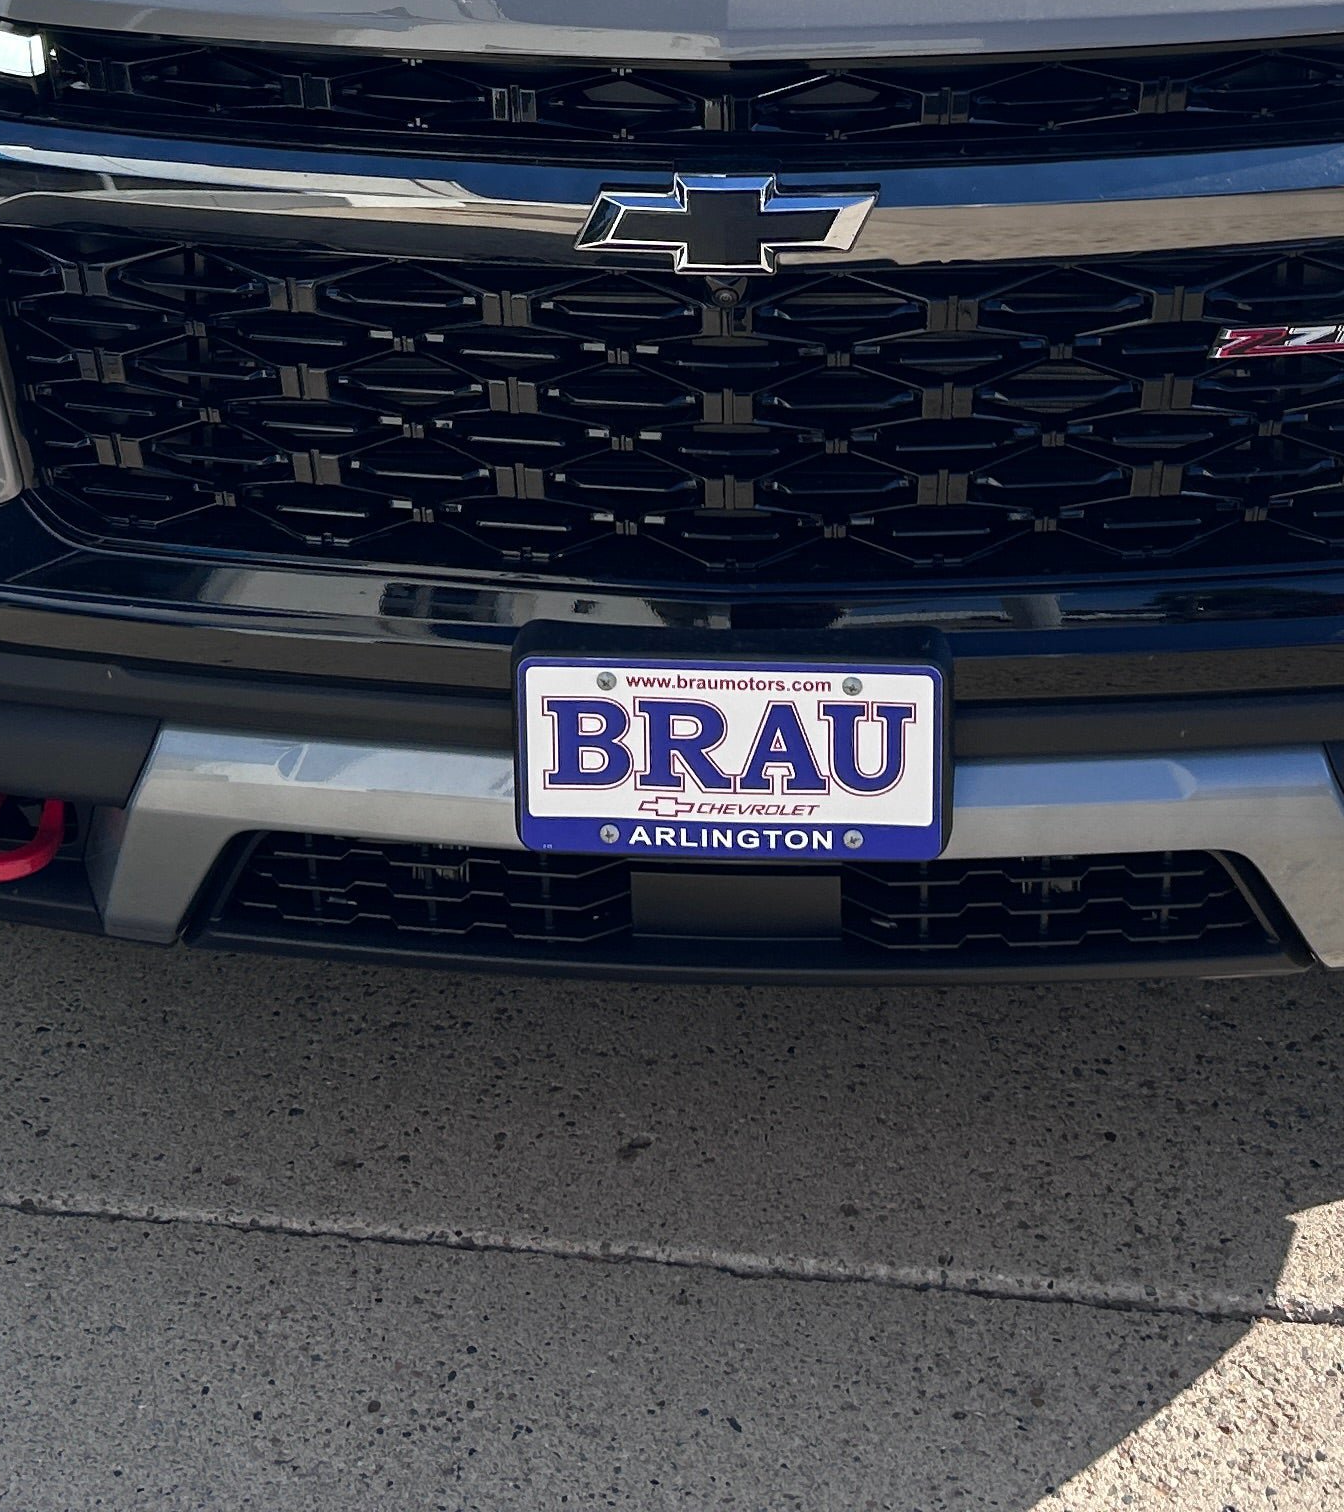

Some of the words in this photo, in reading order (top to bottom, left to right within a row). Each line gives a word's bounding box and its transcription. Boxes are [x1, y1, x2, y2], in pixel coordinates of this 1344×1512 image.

[626, 673, 832, 694] www.braumotors.com
[541, 695, 917, 798] BRAU
[696, 801, 820, 818] CHEVROLET
[628, 824, 834, 851] ARLINGTON
